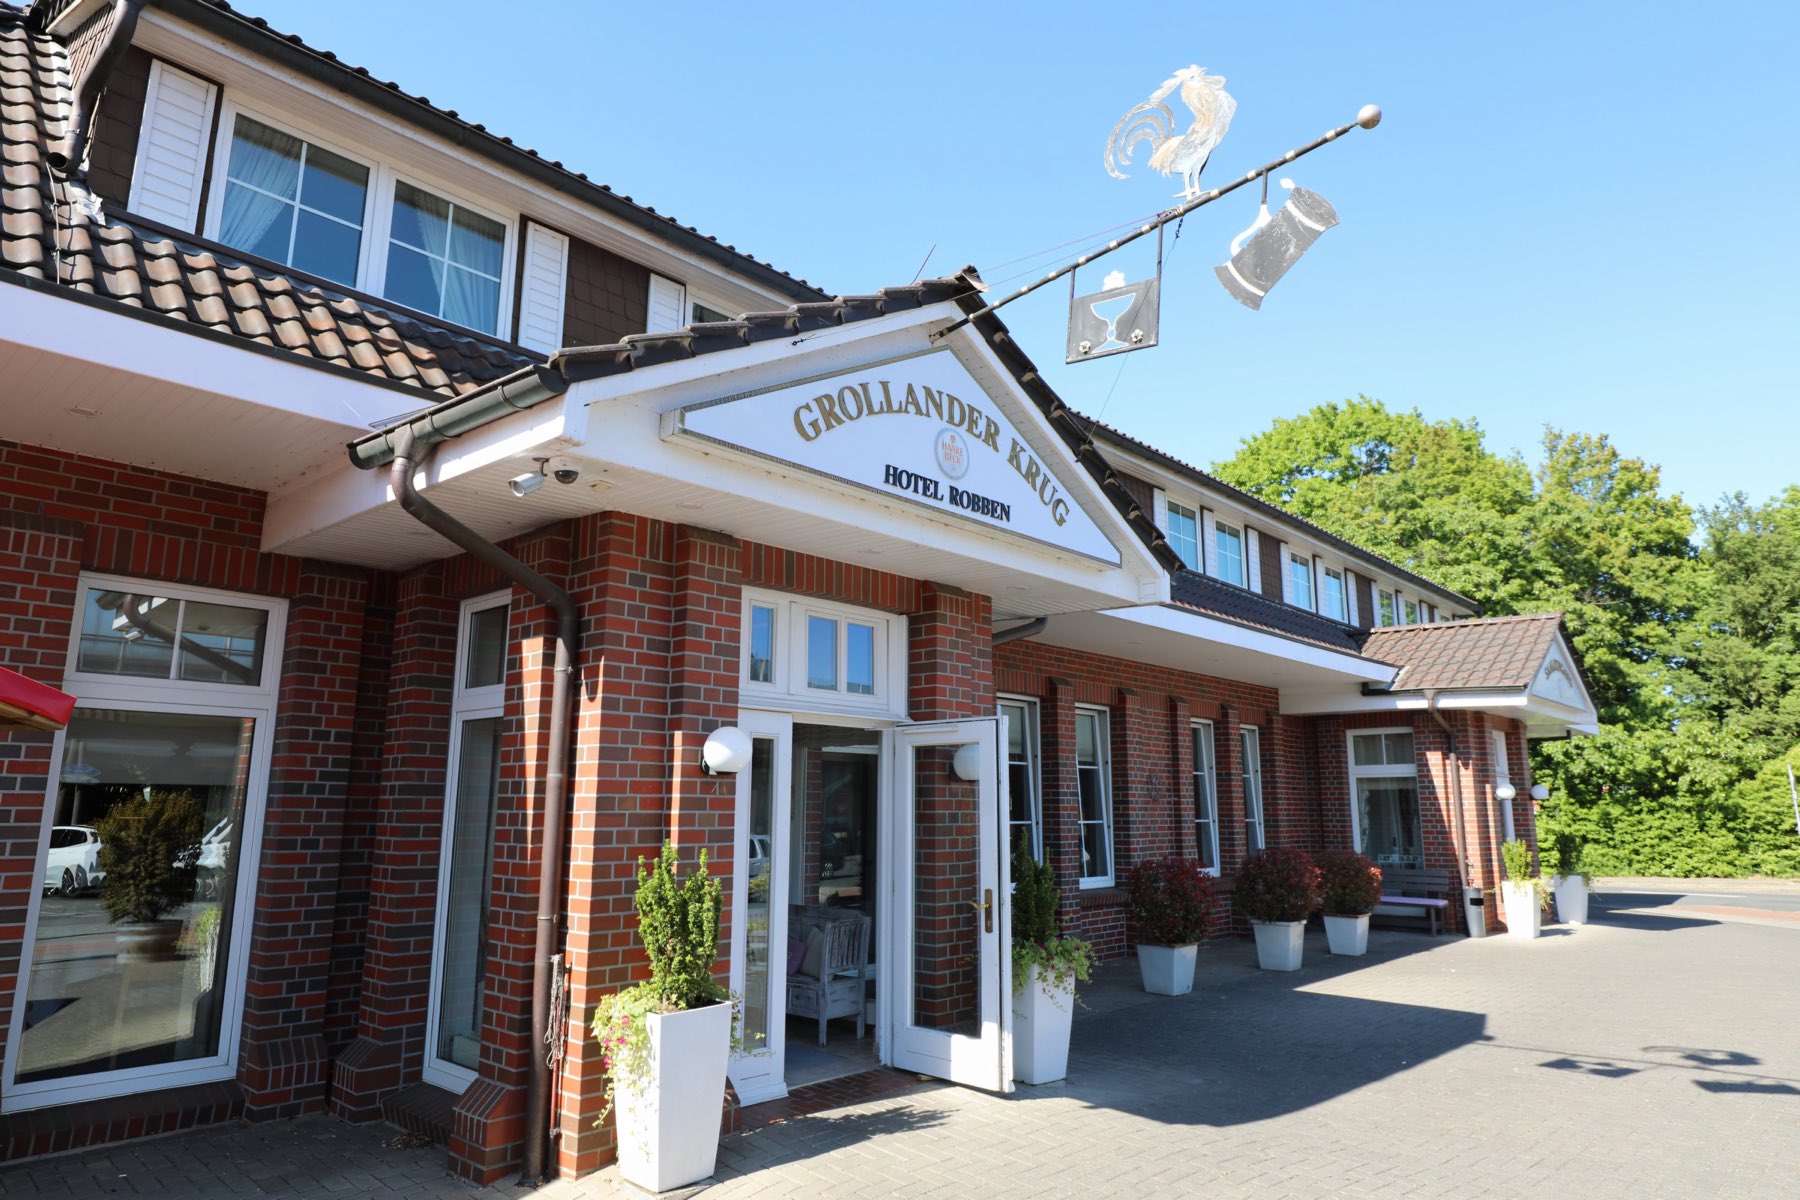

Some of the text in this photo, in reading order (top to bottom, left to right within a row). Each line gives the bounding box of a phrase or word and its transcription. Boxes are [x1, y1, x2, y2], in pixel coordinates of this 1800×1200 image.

[793, 380, 1070, 527] GROLLANDER KRUG
[883, 464, 1011, 522] HOTEL ROBBEN
